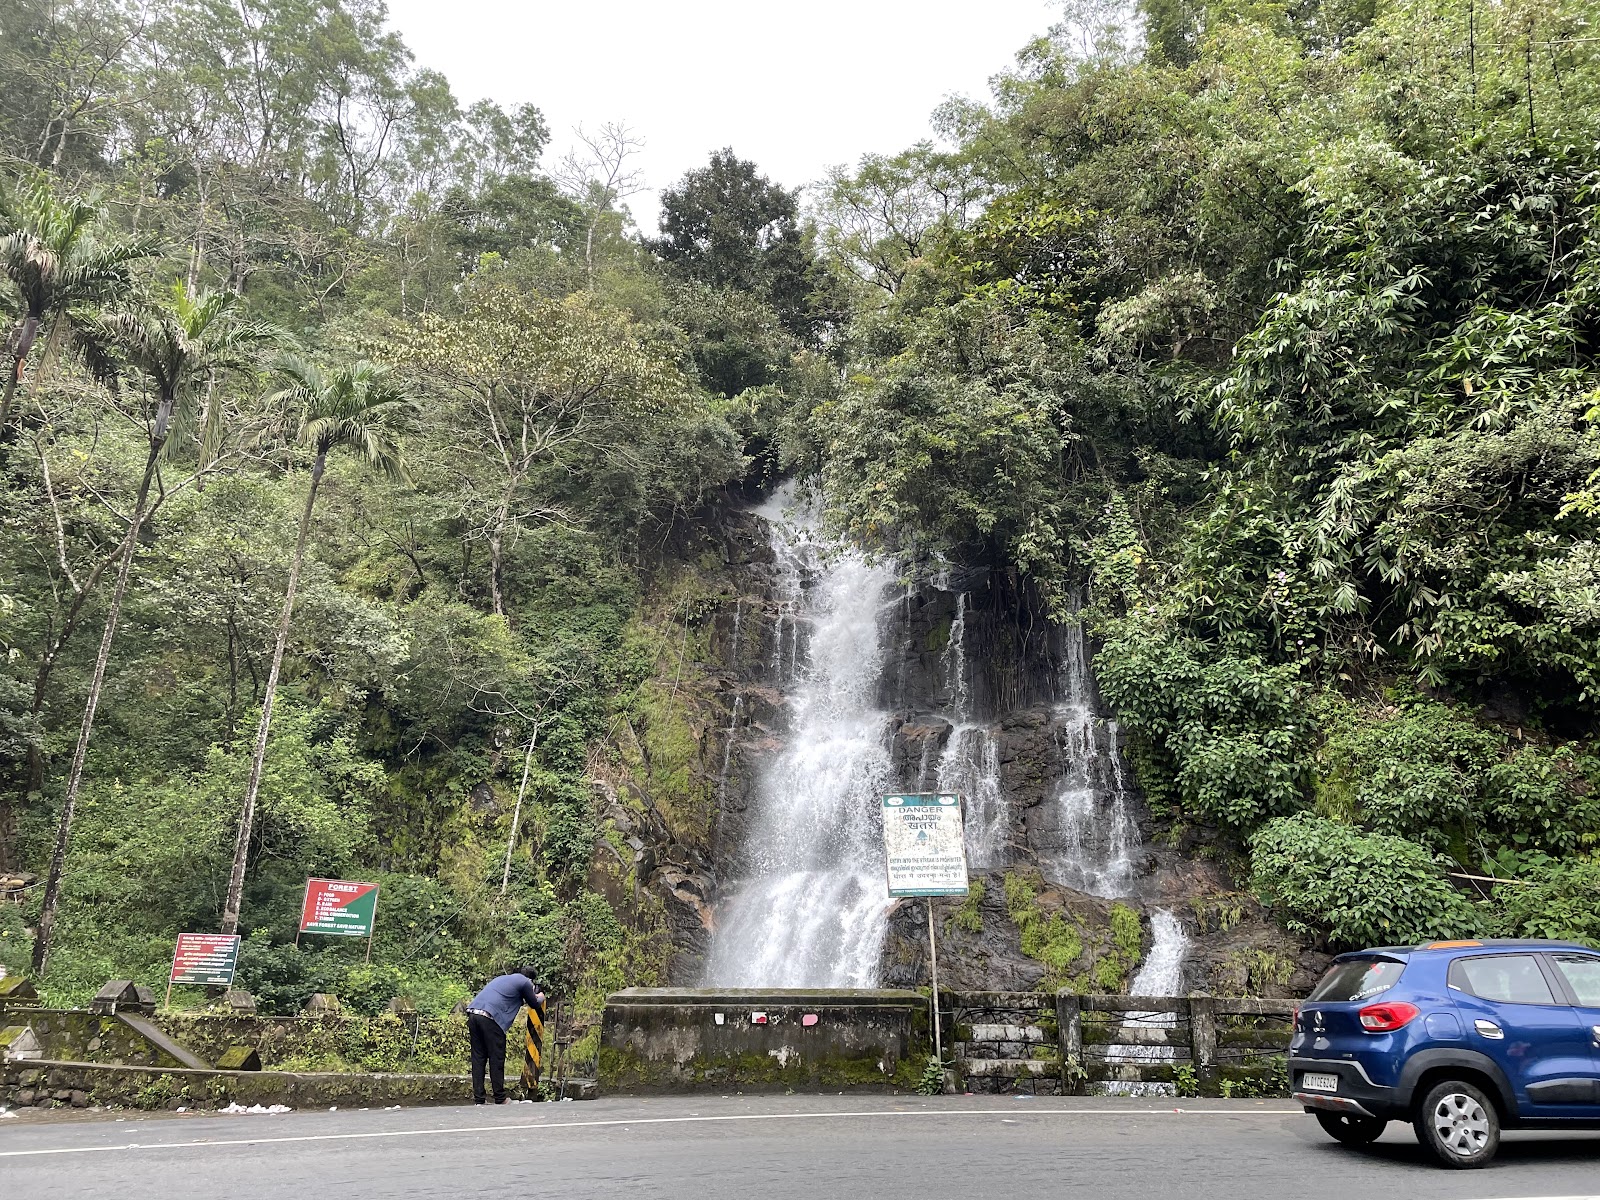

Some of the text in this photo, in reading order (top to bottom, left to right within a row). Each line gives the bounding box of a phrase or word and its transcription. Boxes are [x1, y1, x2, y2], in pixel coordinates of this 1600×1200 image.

[907, 822, 938, 830] खतरा
[328, 884, 358, 892] FOREST
[1349, 985, 1390, 1001] CLIMBER
